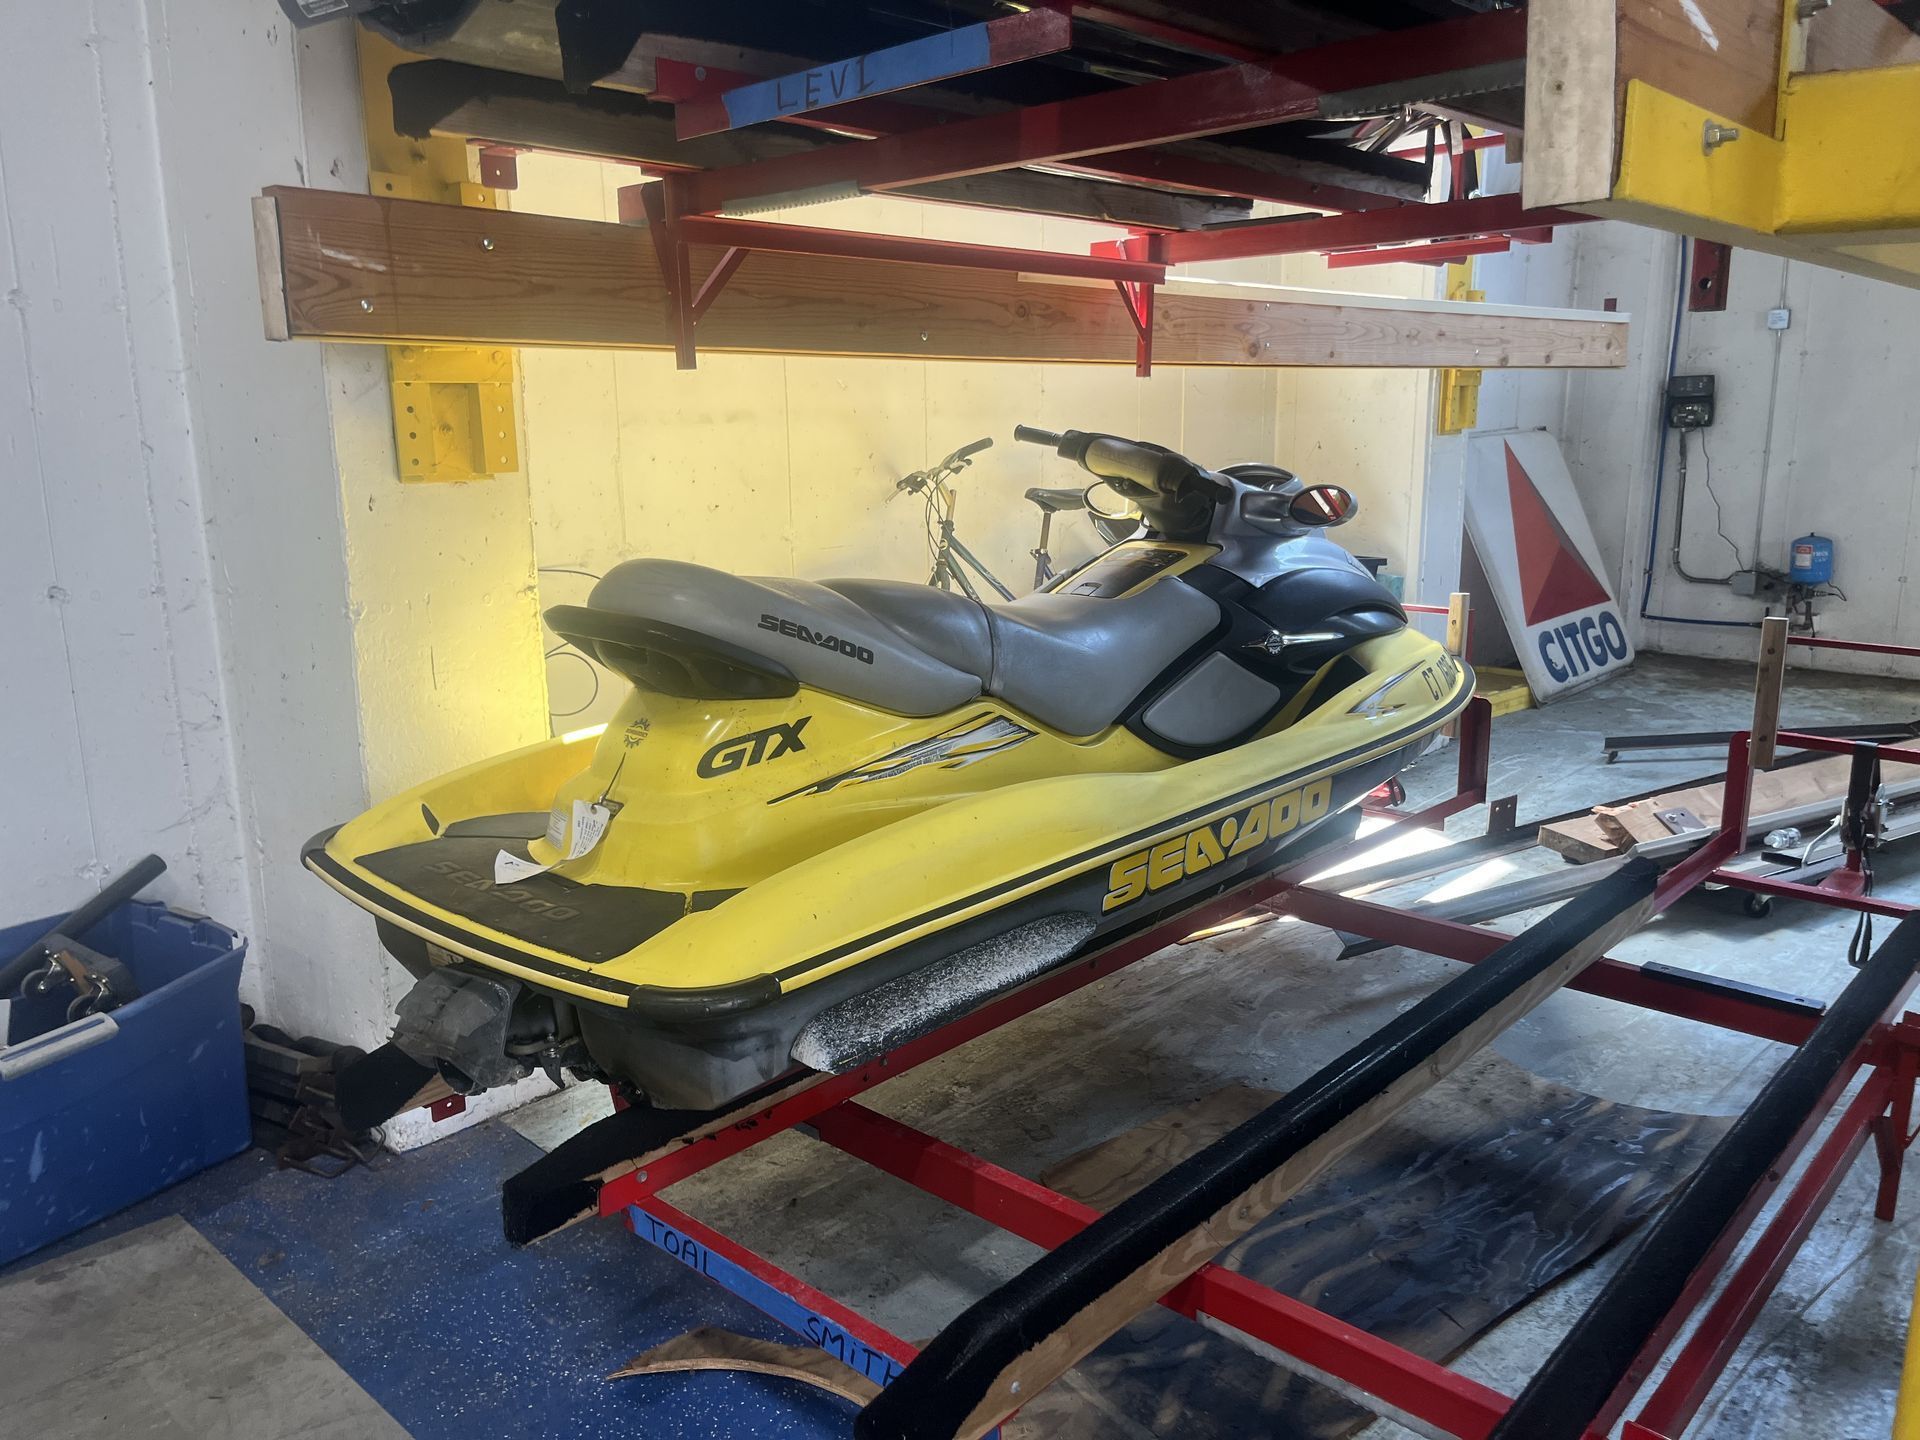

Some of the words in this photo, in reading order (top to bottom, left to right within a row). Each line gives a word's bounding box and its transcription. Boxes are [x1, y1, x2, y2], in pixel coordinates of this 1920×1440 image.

[776, 55, 875, 111] LEVI
[1538, 610, 1627, 683] CITGO
[697, 715, 813, 779] GTX
[644, 1213, 720, 1284] TOAL
